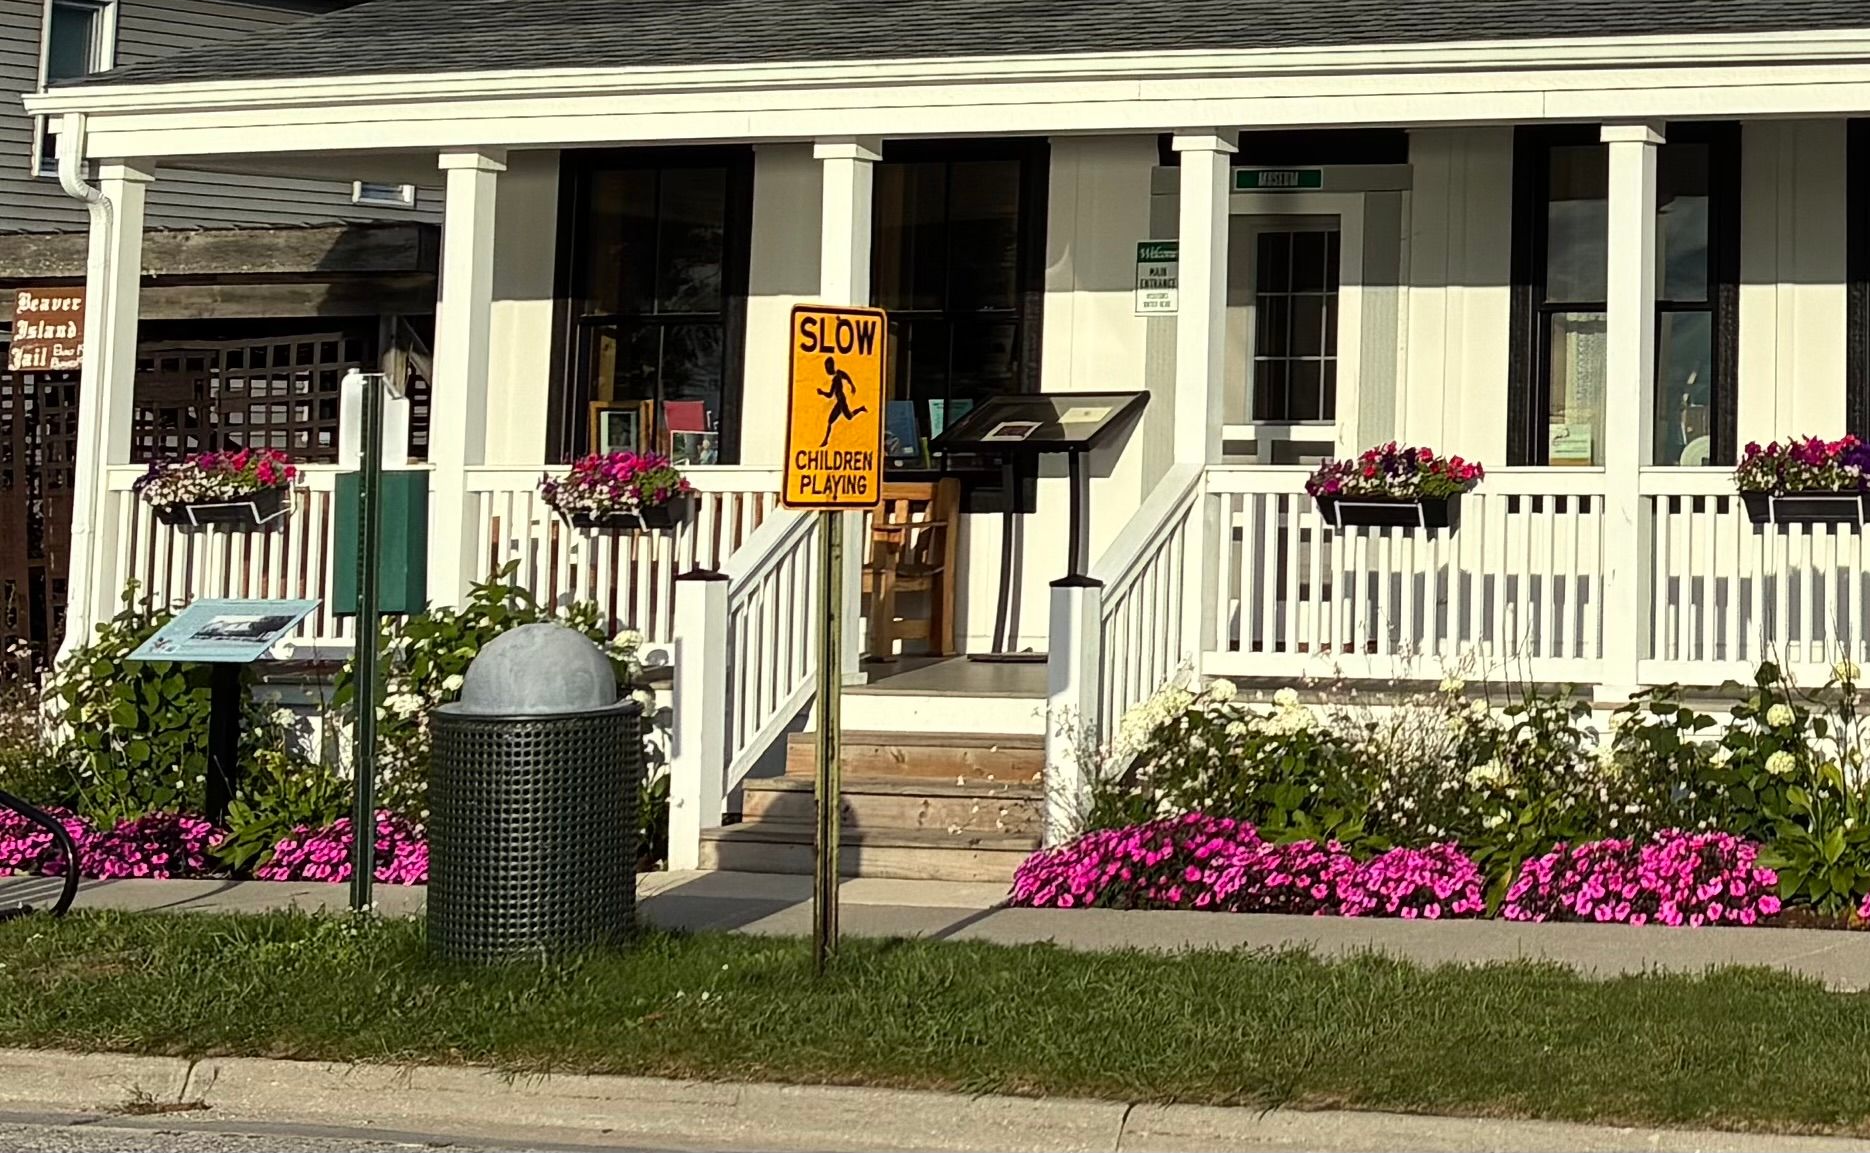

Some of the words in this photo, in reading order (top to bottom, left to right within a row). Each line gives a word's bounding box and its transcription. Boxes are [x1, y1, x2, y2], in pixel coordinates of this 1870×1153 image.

[16, 292, 82, 314] Beaver
[13, 319, 77, 341] Island
[799, 315, 877, 356] SLOW
[8, 347, 48, 371] Jail
[795, 449, 873, 472] CHILDREN
[799, 474, 868, 496] PLAYING
